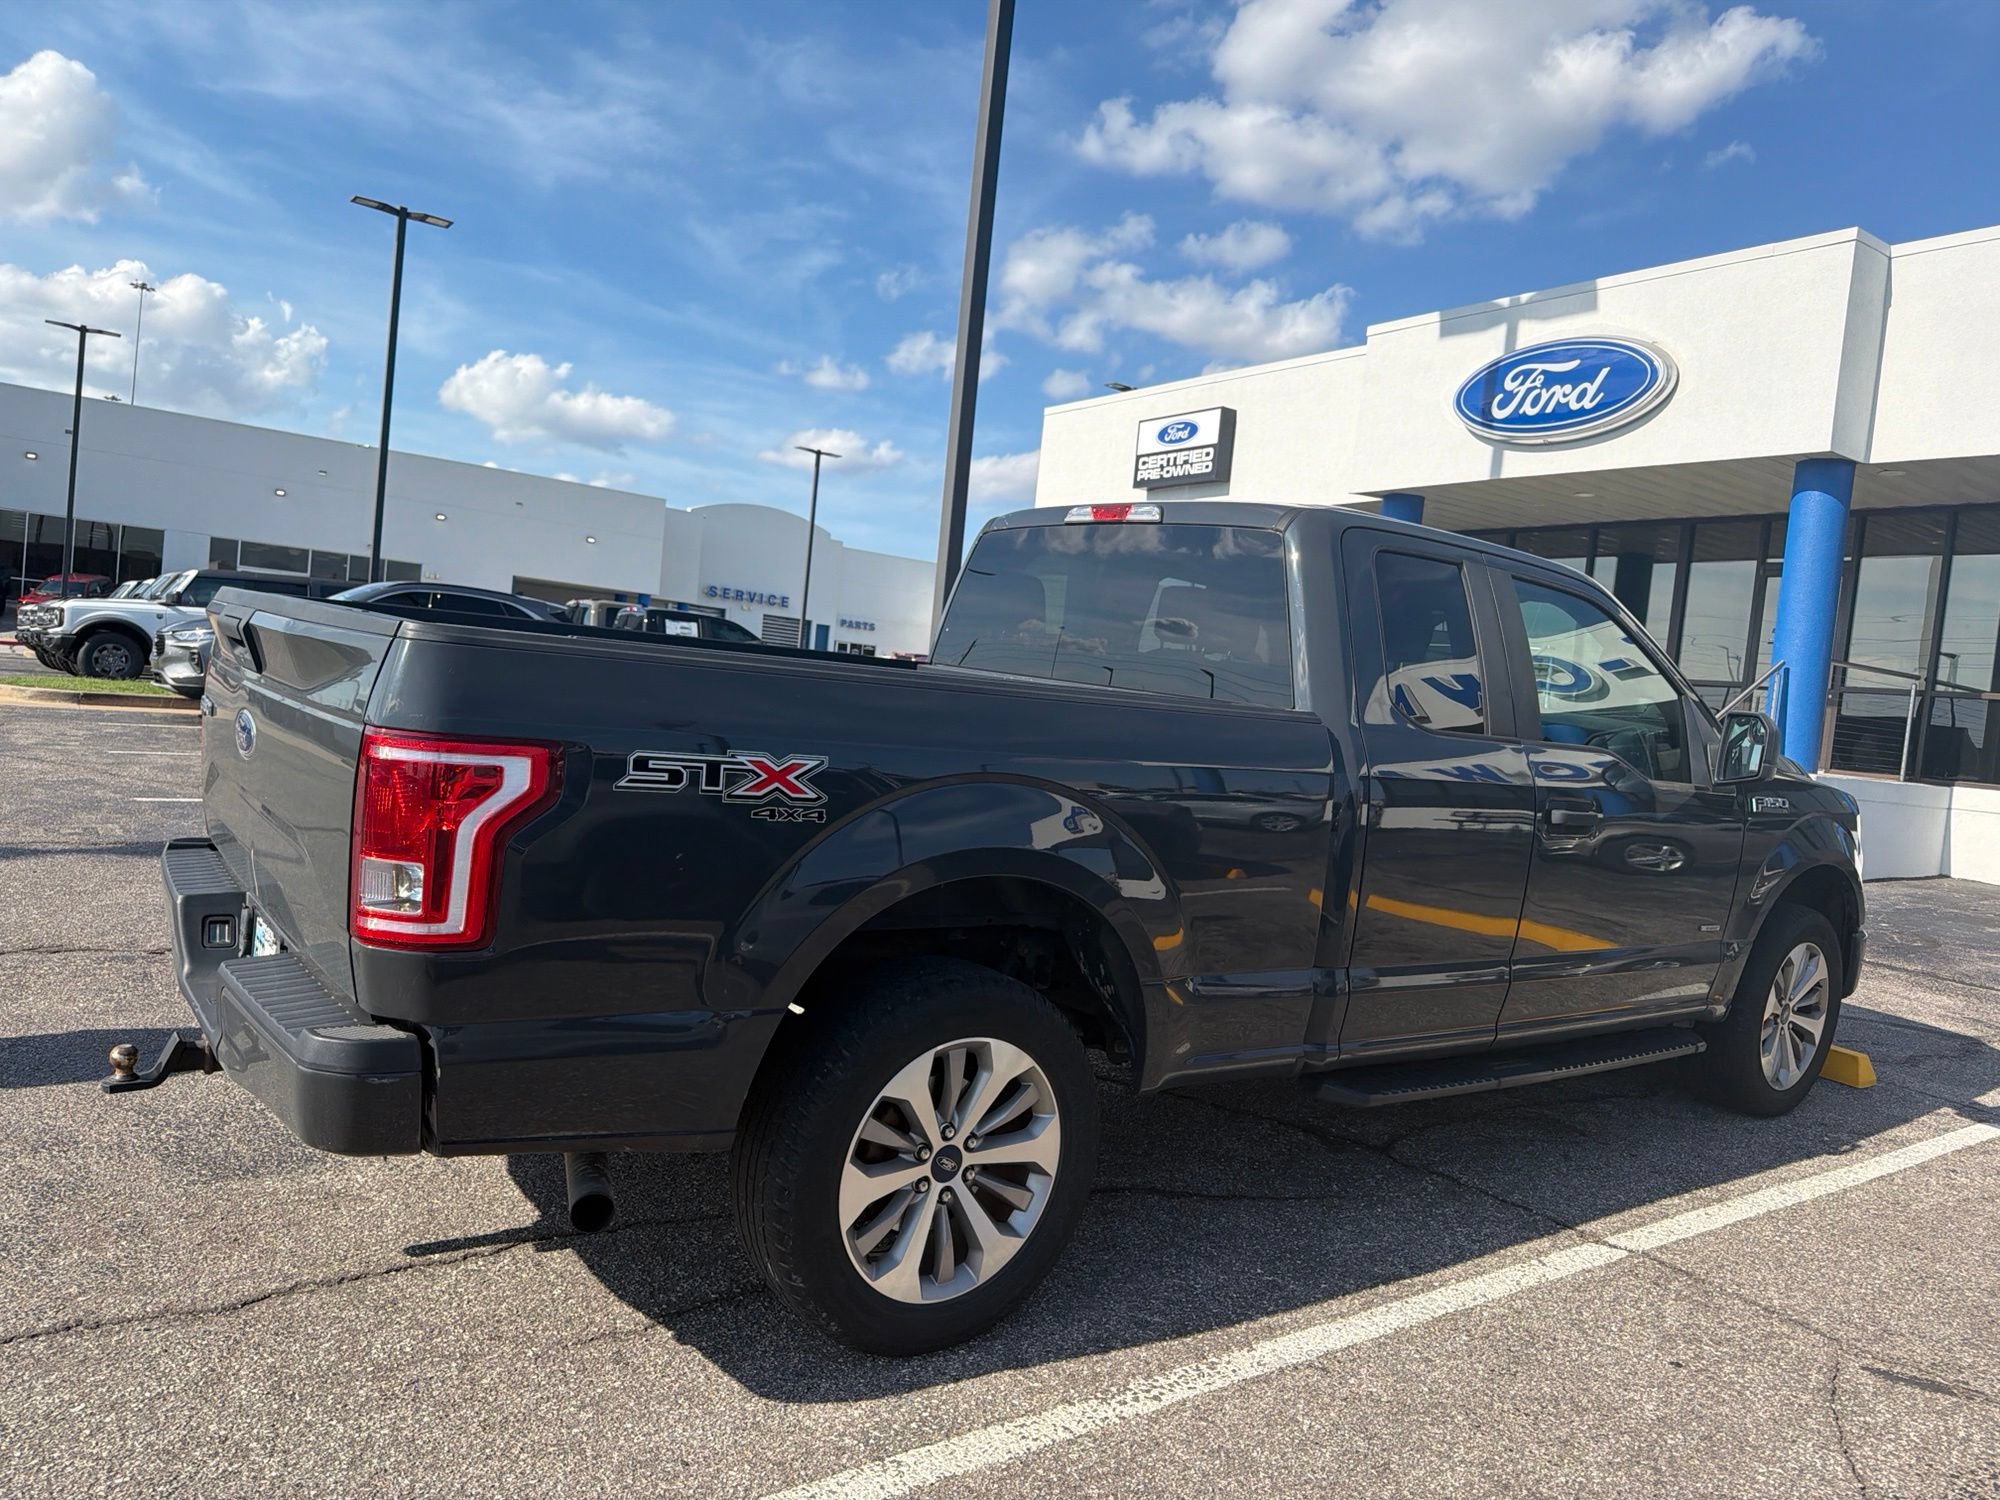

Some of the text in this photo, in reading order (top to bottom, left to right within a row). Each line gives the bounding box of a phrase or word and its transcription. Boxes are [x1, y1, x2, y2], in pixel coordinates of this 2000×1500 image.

[1491, 359, 1611, 420] Ford
[1164, 424, 1191, 442] Ford
[1138, 447, 1214, 470] CERTIFIED
[1136, 461, 1213, 481] PRE-OWNED
[707, 585, 790, 608] SERVICE
[839, 619, 876, 632] PARTS
[612, 750, 829, 806] STX
